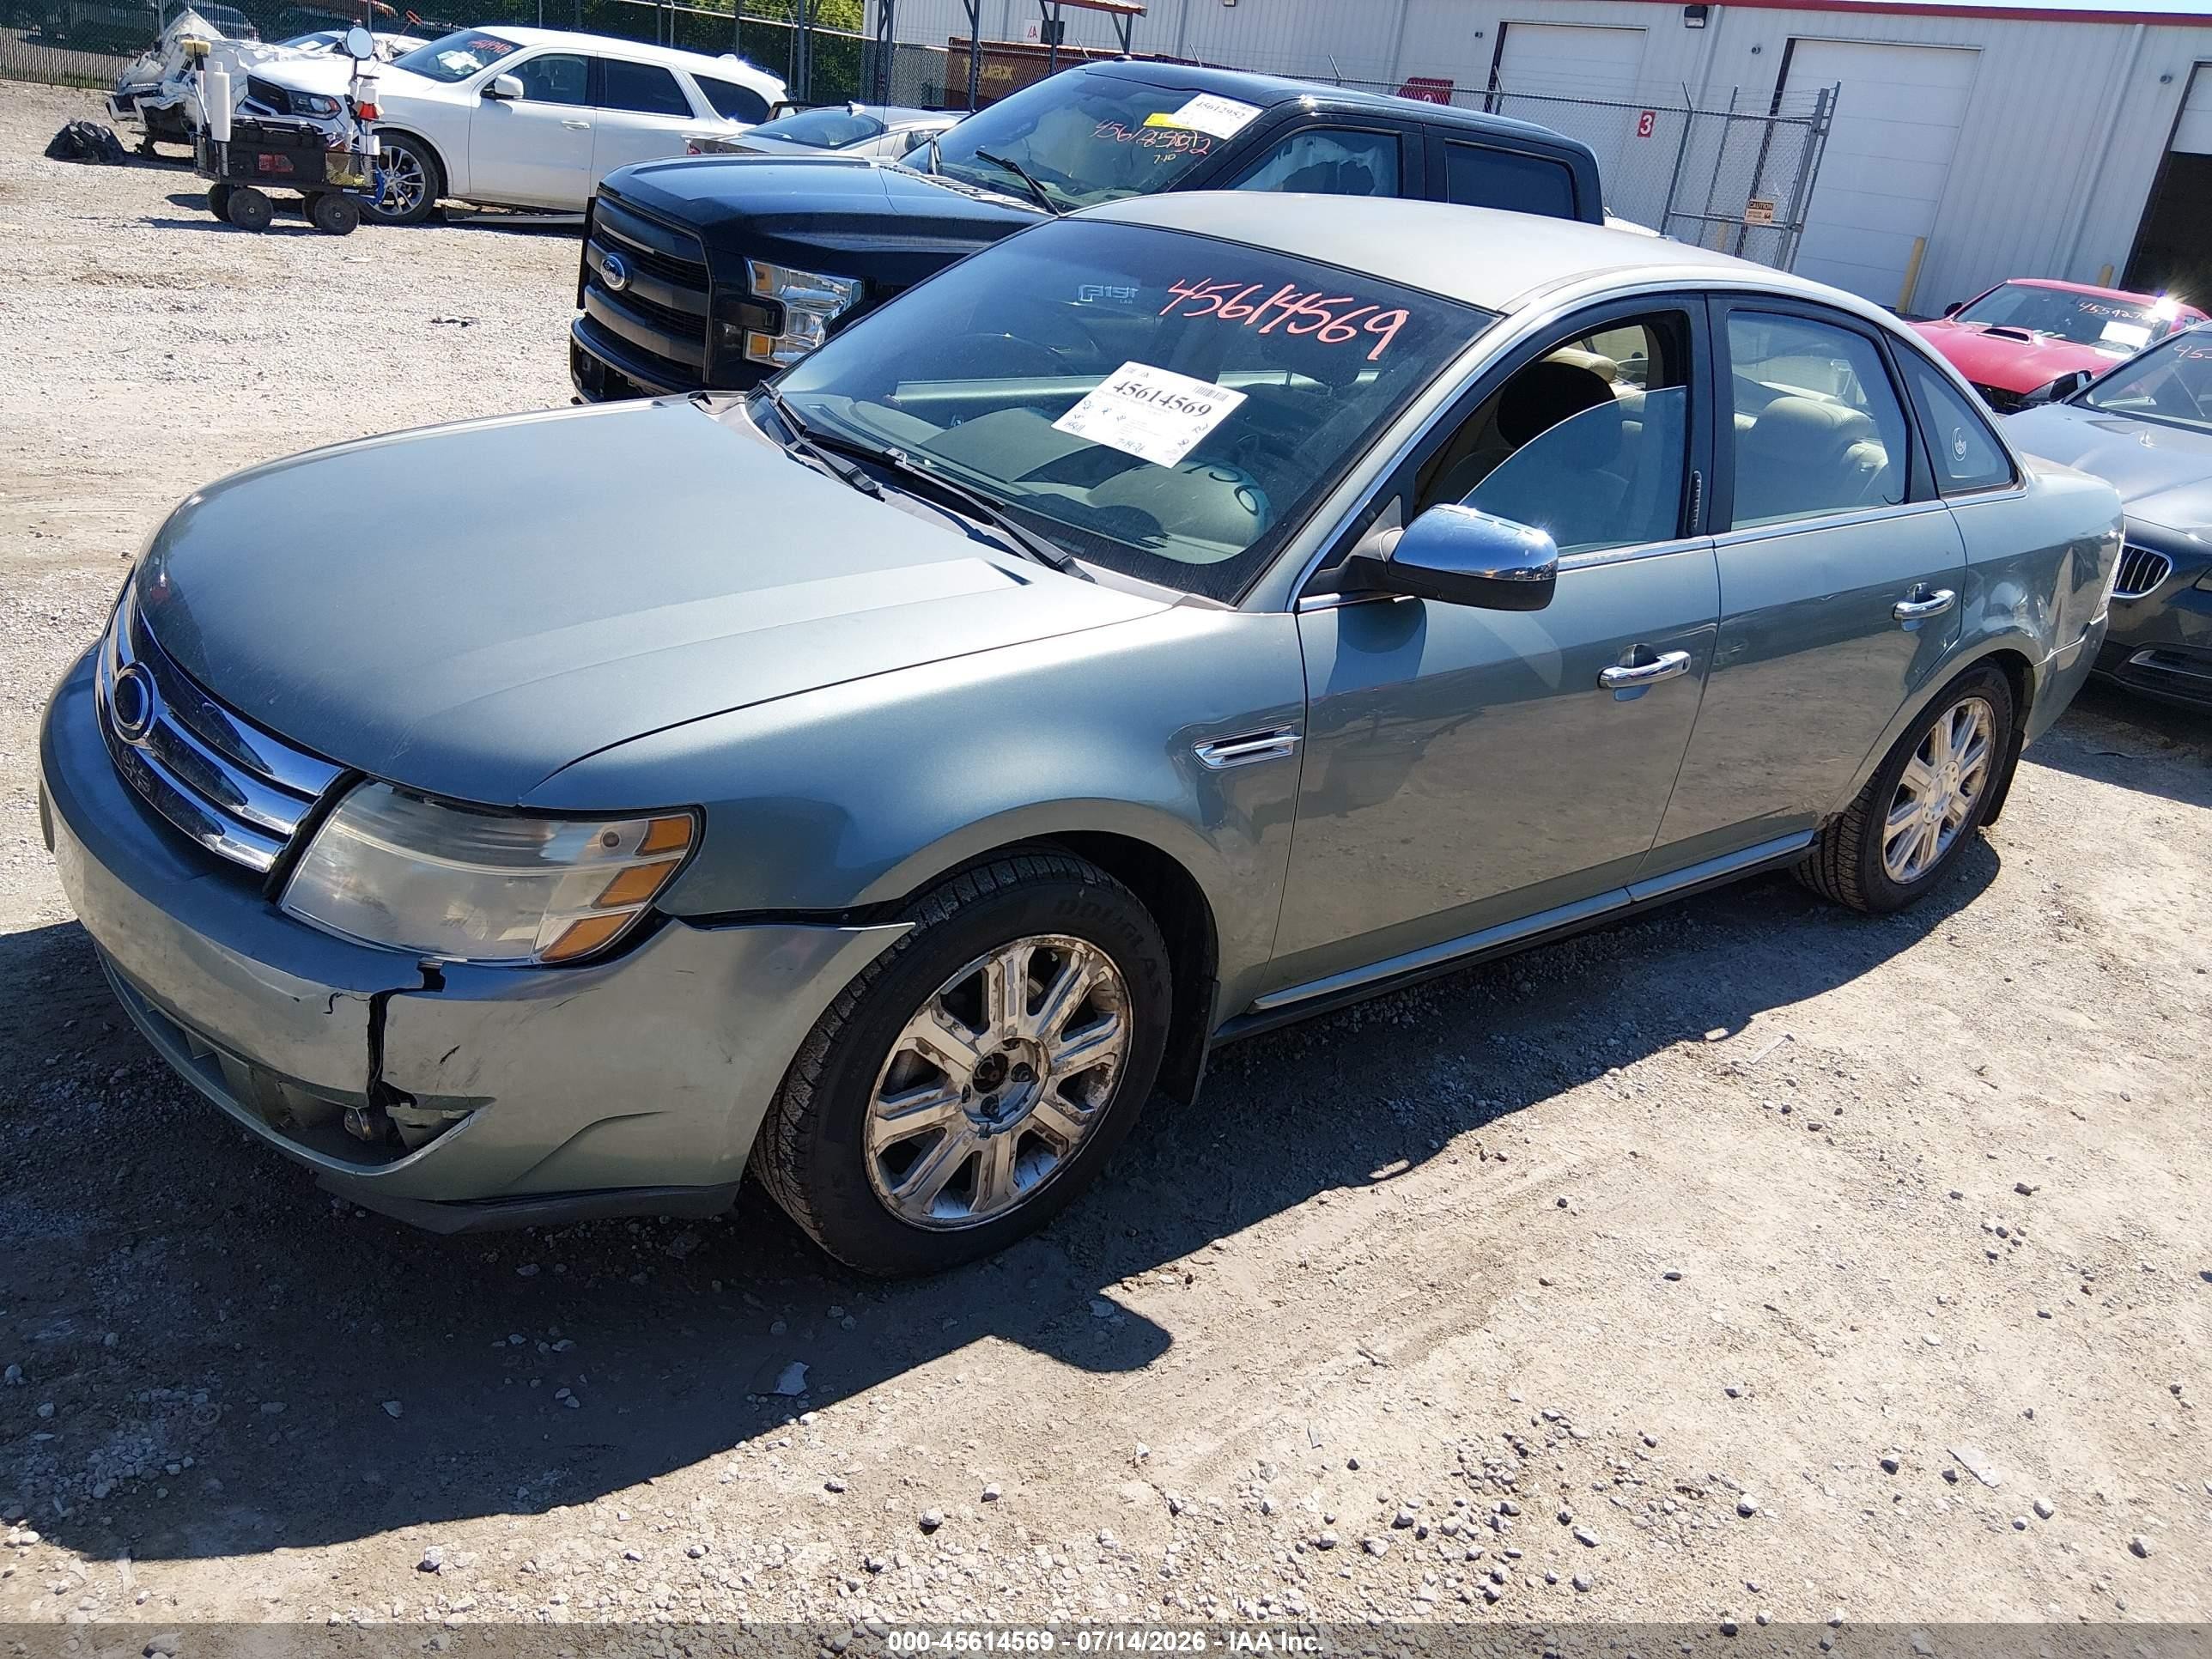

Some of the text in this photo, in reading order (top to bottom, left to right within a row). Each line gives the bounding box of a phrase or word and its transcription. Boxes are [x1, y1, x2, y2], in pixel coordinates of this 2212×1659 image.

[1640, 114, 1653, 135] 3
[1749, 201, 1773, 210] CAUTION
[1158, 277, 1410, 361] 45614569
[1113, 380, 1212, 417] 45614569
